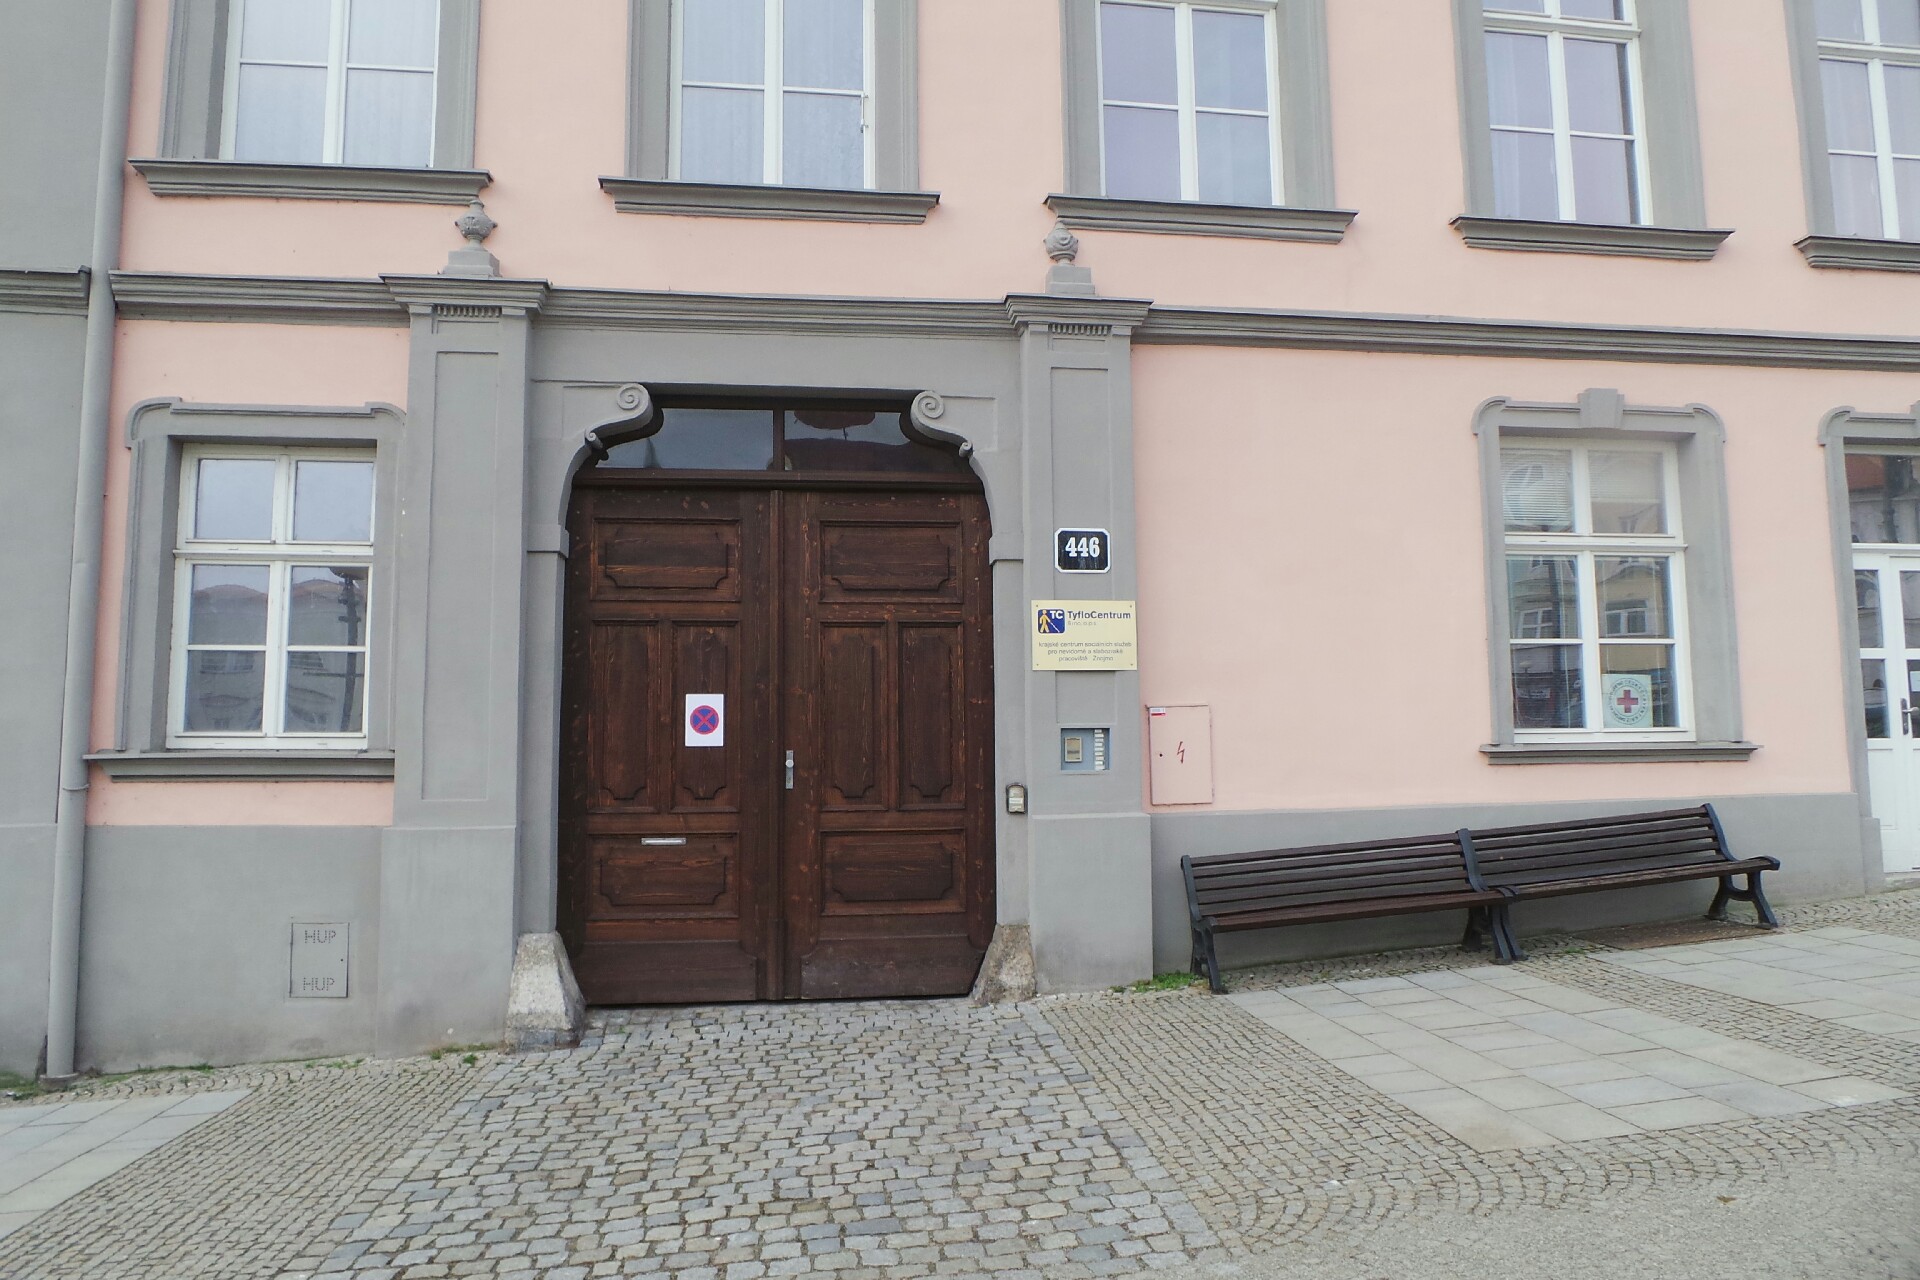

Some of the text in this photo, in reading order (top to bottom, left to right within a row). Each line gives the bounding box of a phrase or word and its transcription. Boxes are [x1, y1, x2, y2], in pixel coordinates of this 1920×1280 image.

[1065, 536, 1100, 558] 446
[1049, 610, 1064, 619] TC
[1067, 610, 1131, 620] TyfloCentrum
[304, 929, 337, 944] HUP
[303, 977, 335, 991] HUP
